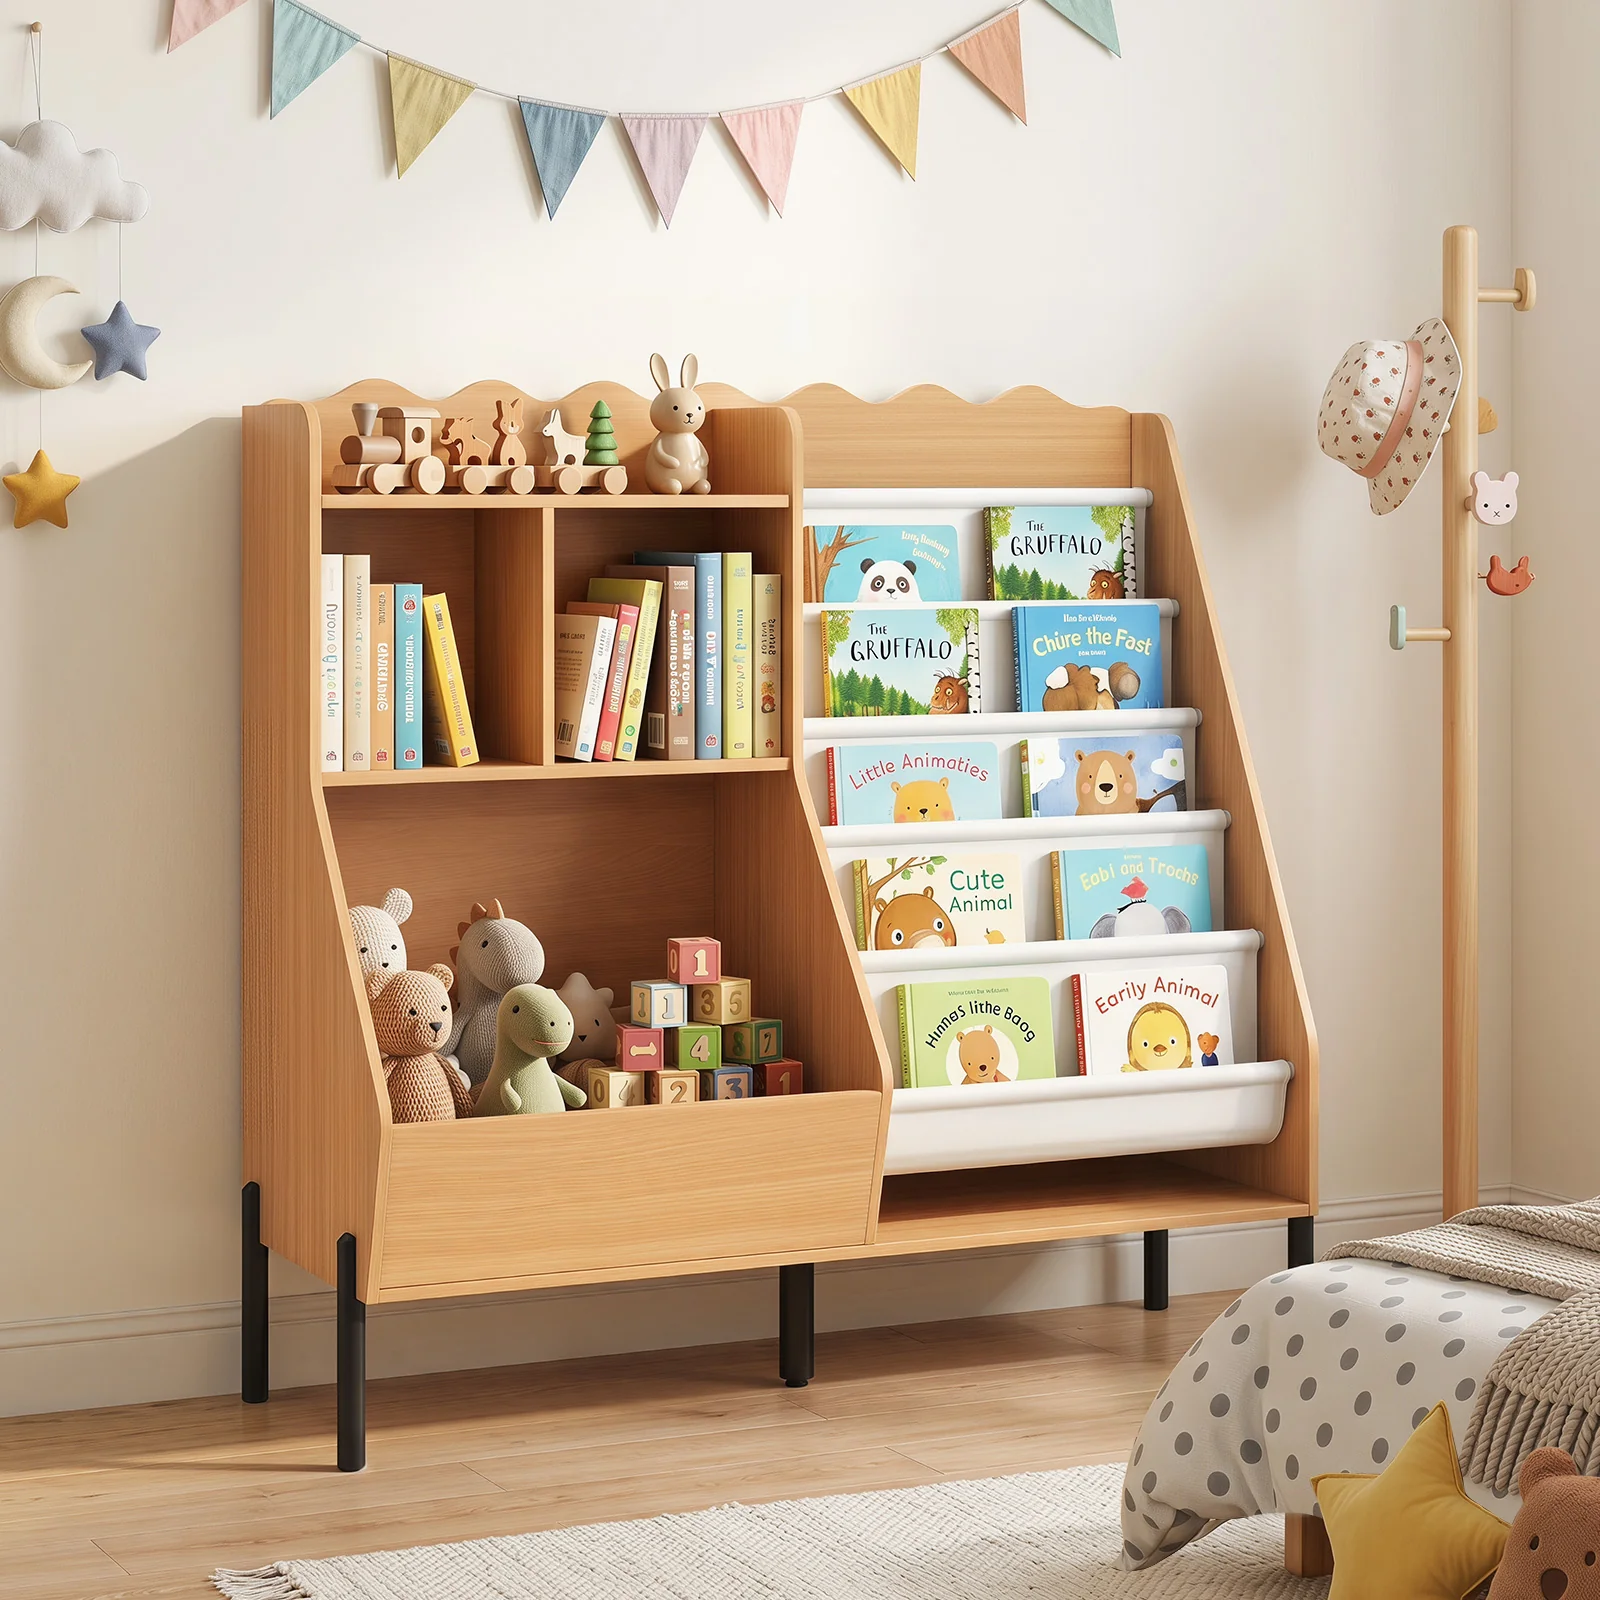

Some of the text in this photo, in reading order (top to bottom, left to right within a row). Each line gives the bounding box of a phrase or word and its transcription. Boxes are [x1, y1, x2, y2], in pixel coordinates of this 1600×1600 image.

[1011, 534, 1102, 556] GRUFFALO
[867, 622, 887, 635] THE
[1085, 626, 1112, 645] the
[1115, 628, 1152, 656] Fast
[851, 638, 952, 661] GRUFFALO
[849, 752, 989, 790] Little Animaties
[950, 869, 1004, 890] Cute
[1149, 857, 1199, 886] Trochs
[949, 893, 1012, 912] Animal
[693, 949, 709, 977] 1
[662, 992, 675, 1019] 1
[701, 989, 715, 1015] 3
[1095, 976, 1219, 1014] Earily Animal
[969, 1000, 1001, 1016] lithe
[1004, 1006, 1036, 1043] Baog
[690, 1035, 711, 1062] 4
[732, 1031, 746, 1057] 8
[670, 1080, 688, 1104] 2
